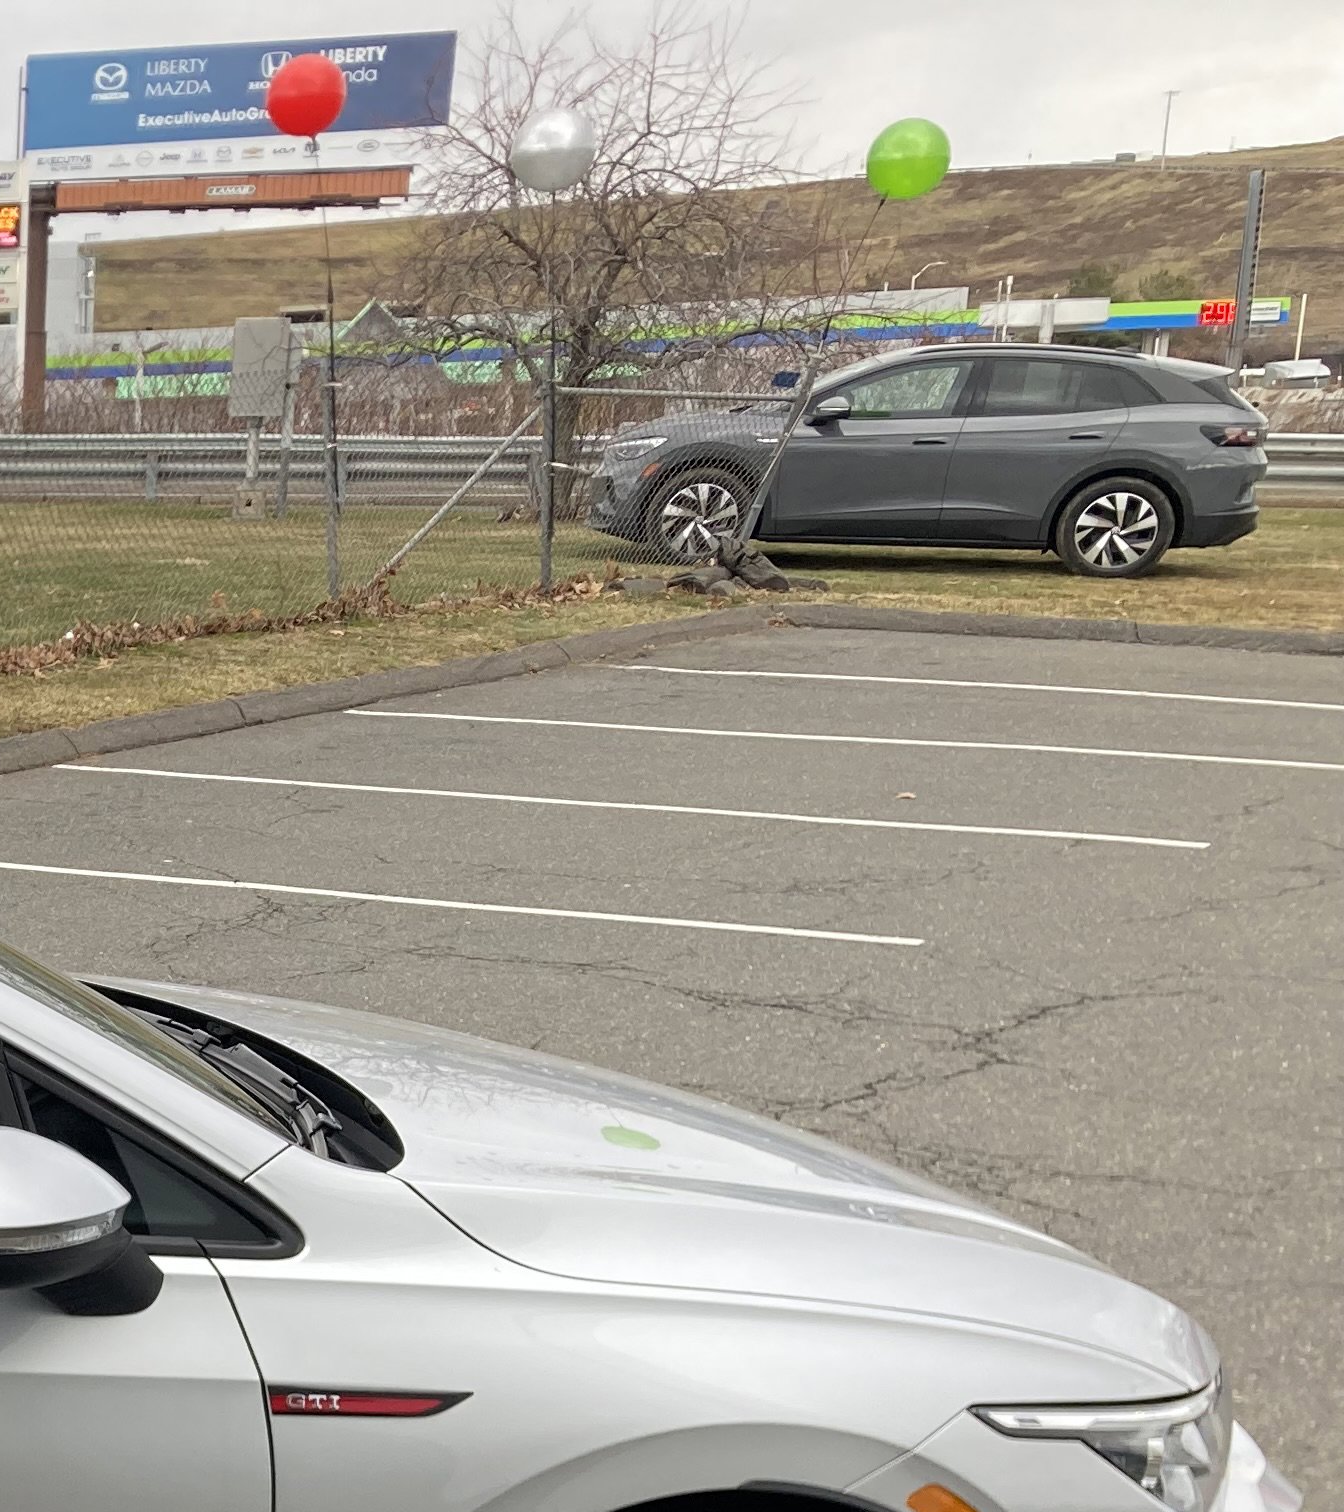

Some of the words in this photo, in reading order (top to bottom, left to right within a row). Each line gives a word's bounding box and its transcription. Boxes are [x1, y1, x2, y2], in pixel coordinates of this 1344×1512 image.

[146, 57, 209, 76] LIBERTY
[344, 66, 378, 82] nda
[145, 79, 212, 97] MAZDA
[287, 1392, 341, 1410] GTI
